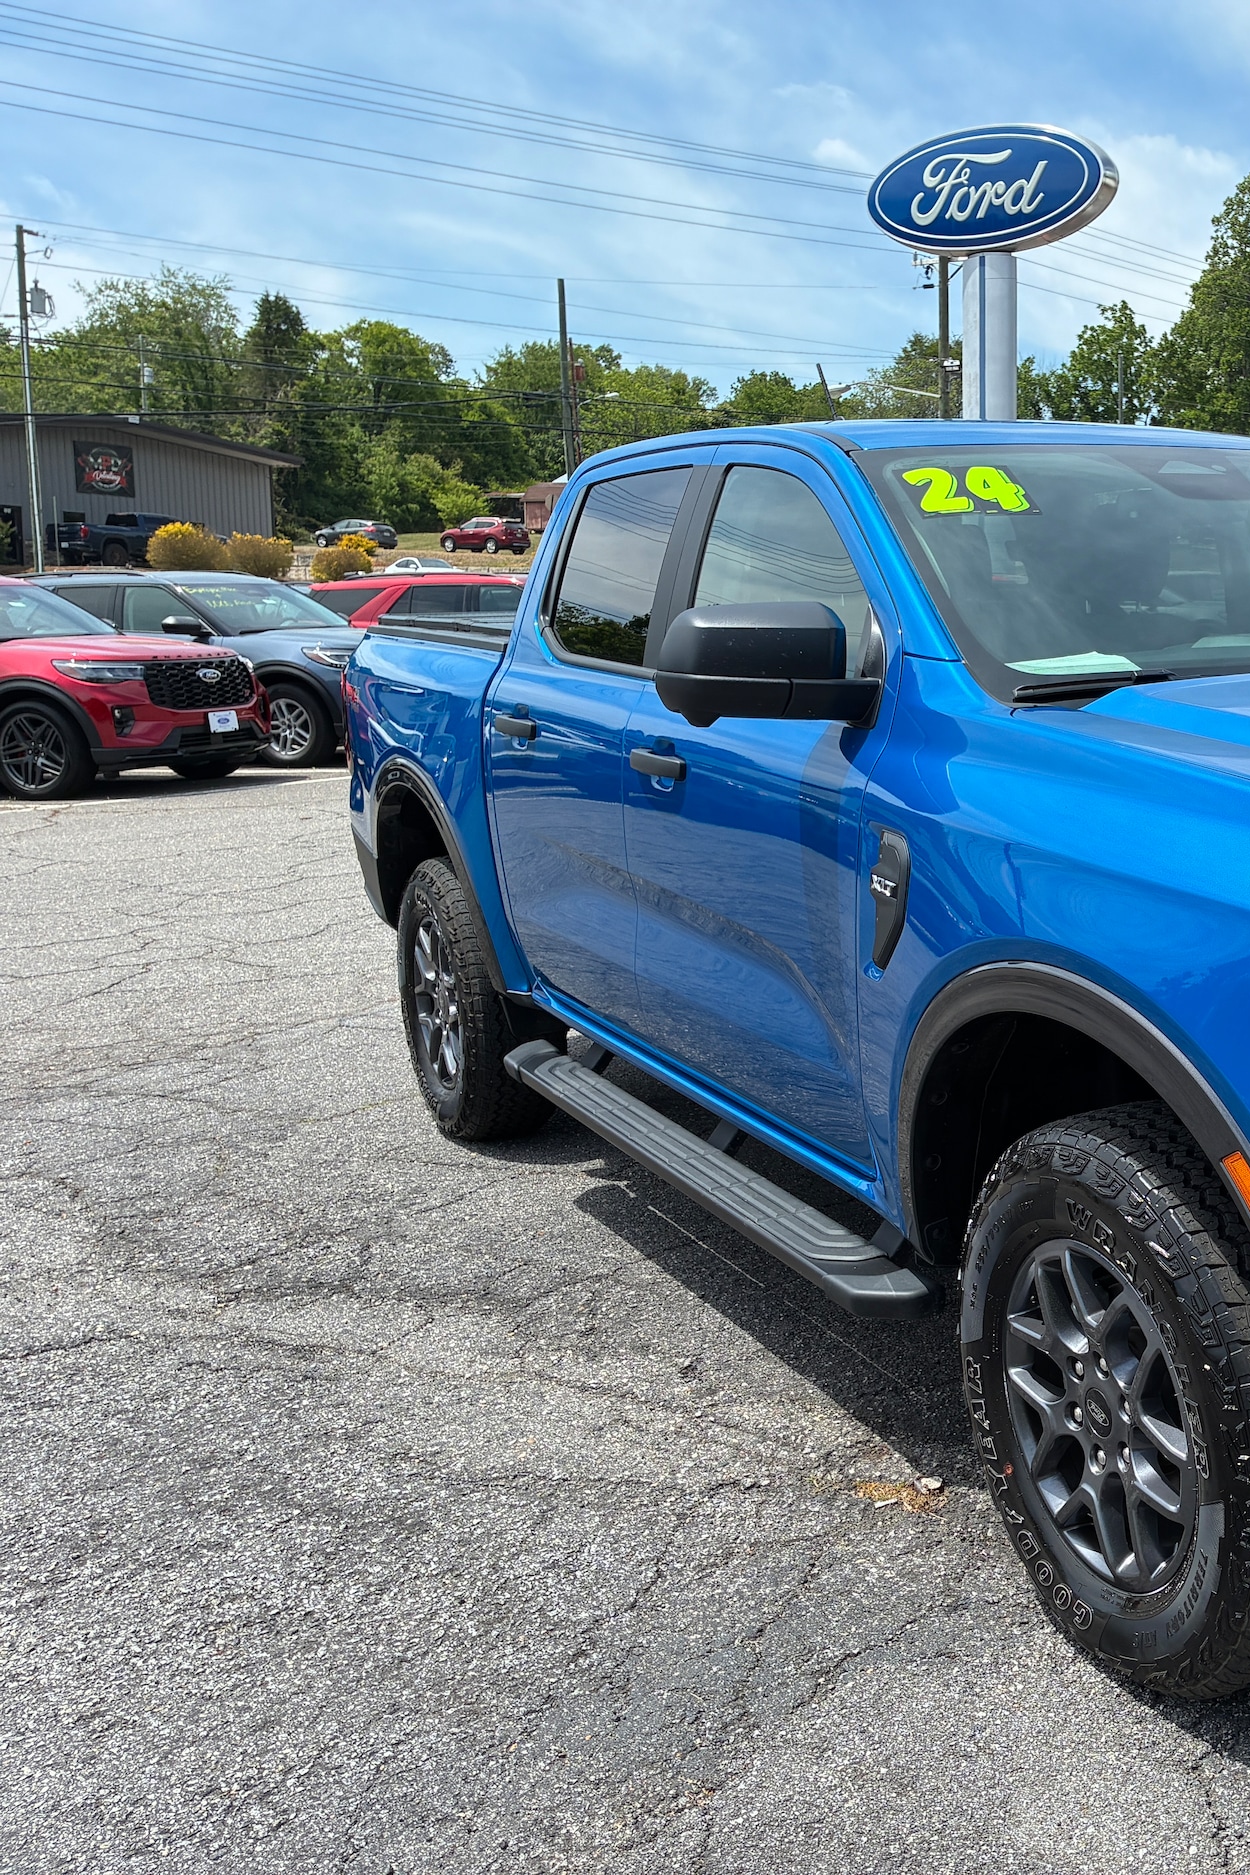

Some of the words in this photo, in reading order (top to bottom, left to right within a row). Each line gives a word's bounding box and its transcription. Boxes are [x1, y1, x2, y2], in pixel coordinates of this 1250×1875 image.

[911, 149, 1048, 226] Ford
[902, 466, 1030, 514] 24
[871, 874, 897, 897] XLT
[1065, 1197, 1209, 1480] WRANGLER
[966, 1355, 1093, 1631] GOODYEAR
[1165, 1548, 1208, 1639] TERRITORY
